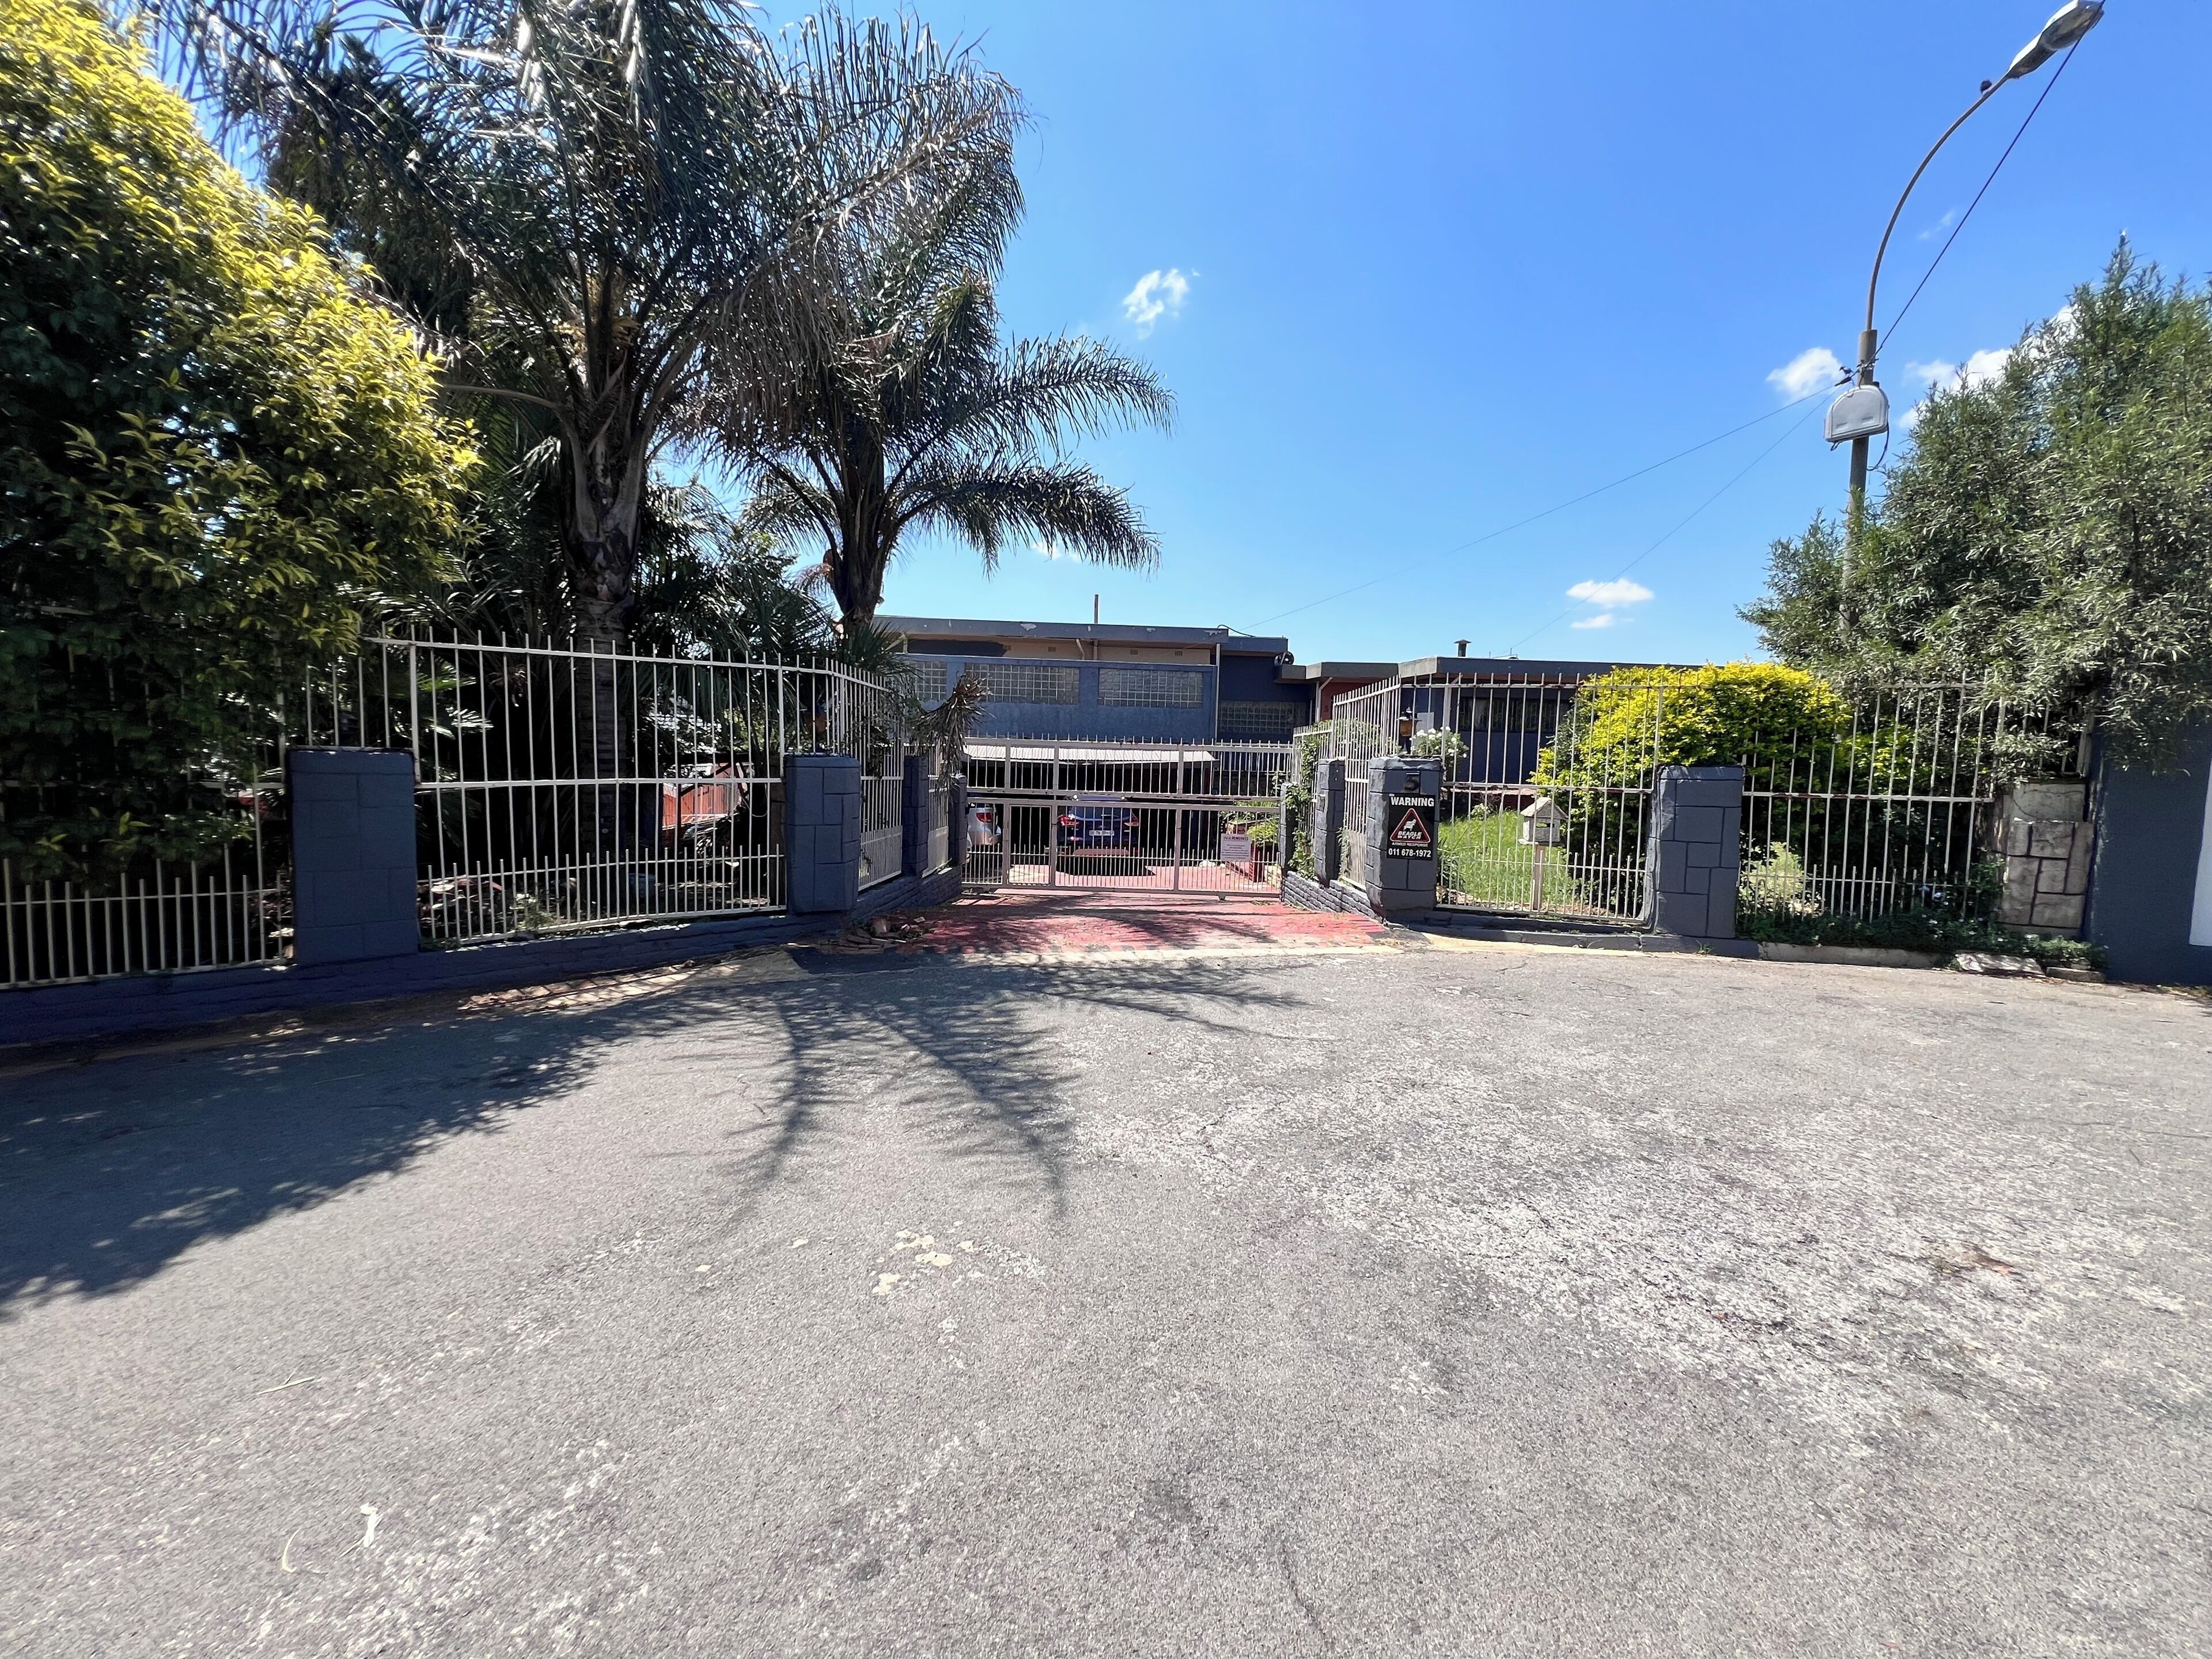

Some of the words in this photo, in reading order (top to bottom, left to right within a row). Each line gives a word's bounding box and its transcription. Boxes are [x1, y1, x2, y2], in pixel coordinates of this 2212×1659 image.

[1391, 797, 1434, 806] WARNING
[1388, 848, 1400, 856] 011
[1402, 849, 1431, 857] 678-1972
